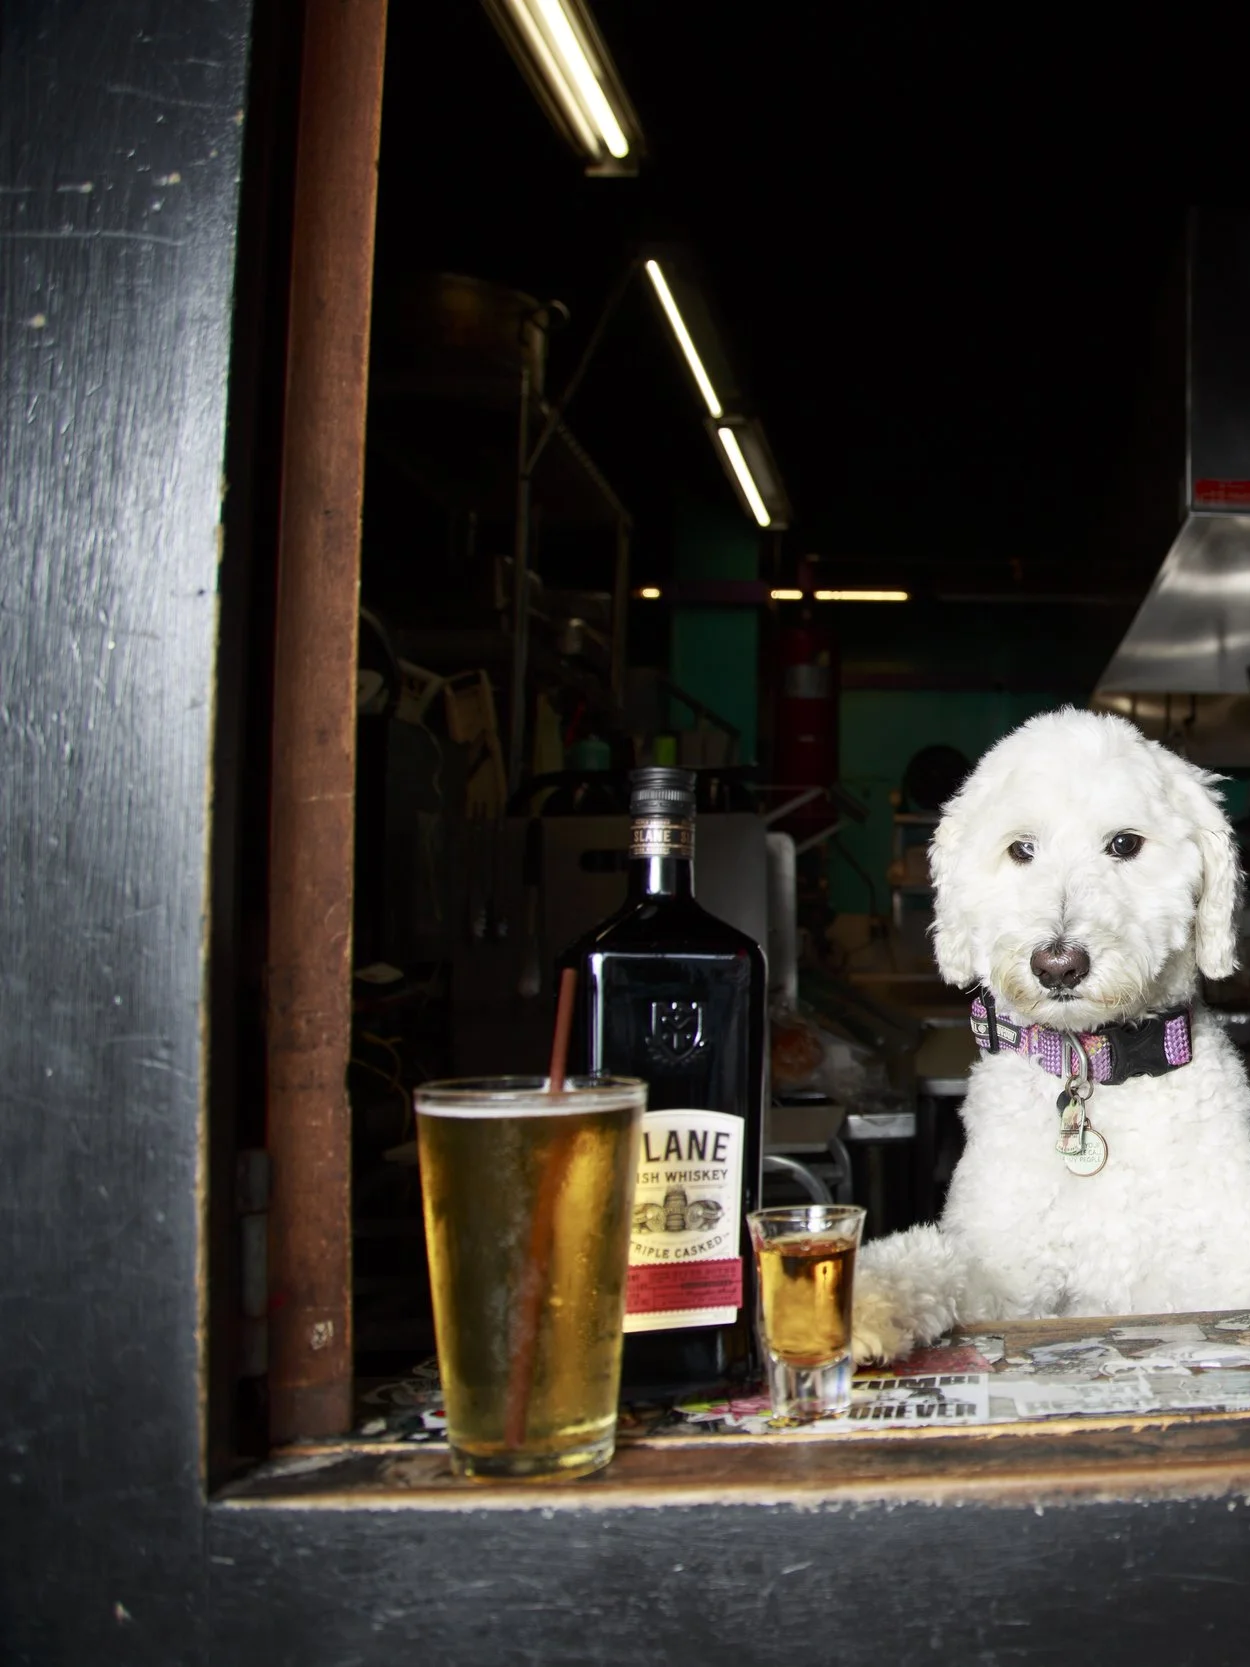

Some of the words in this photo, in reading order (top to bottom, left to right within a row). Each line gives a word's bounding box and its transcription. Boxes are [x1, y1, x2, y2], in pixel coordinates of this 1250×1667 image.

[634, 829, 671, 842] SLANE
[643, 1130, 730, 1162] LANE
[665, 1169, 728, 1182] WHISKEY
[674, 1235, 722, 1259] CASKED
